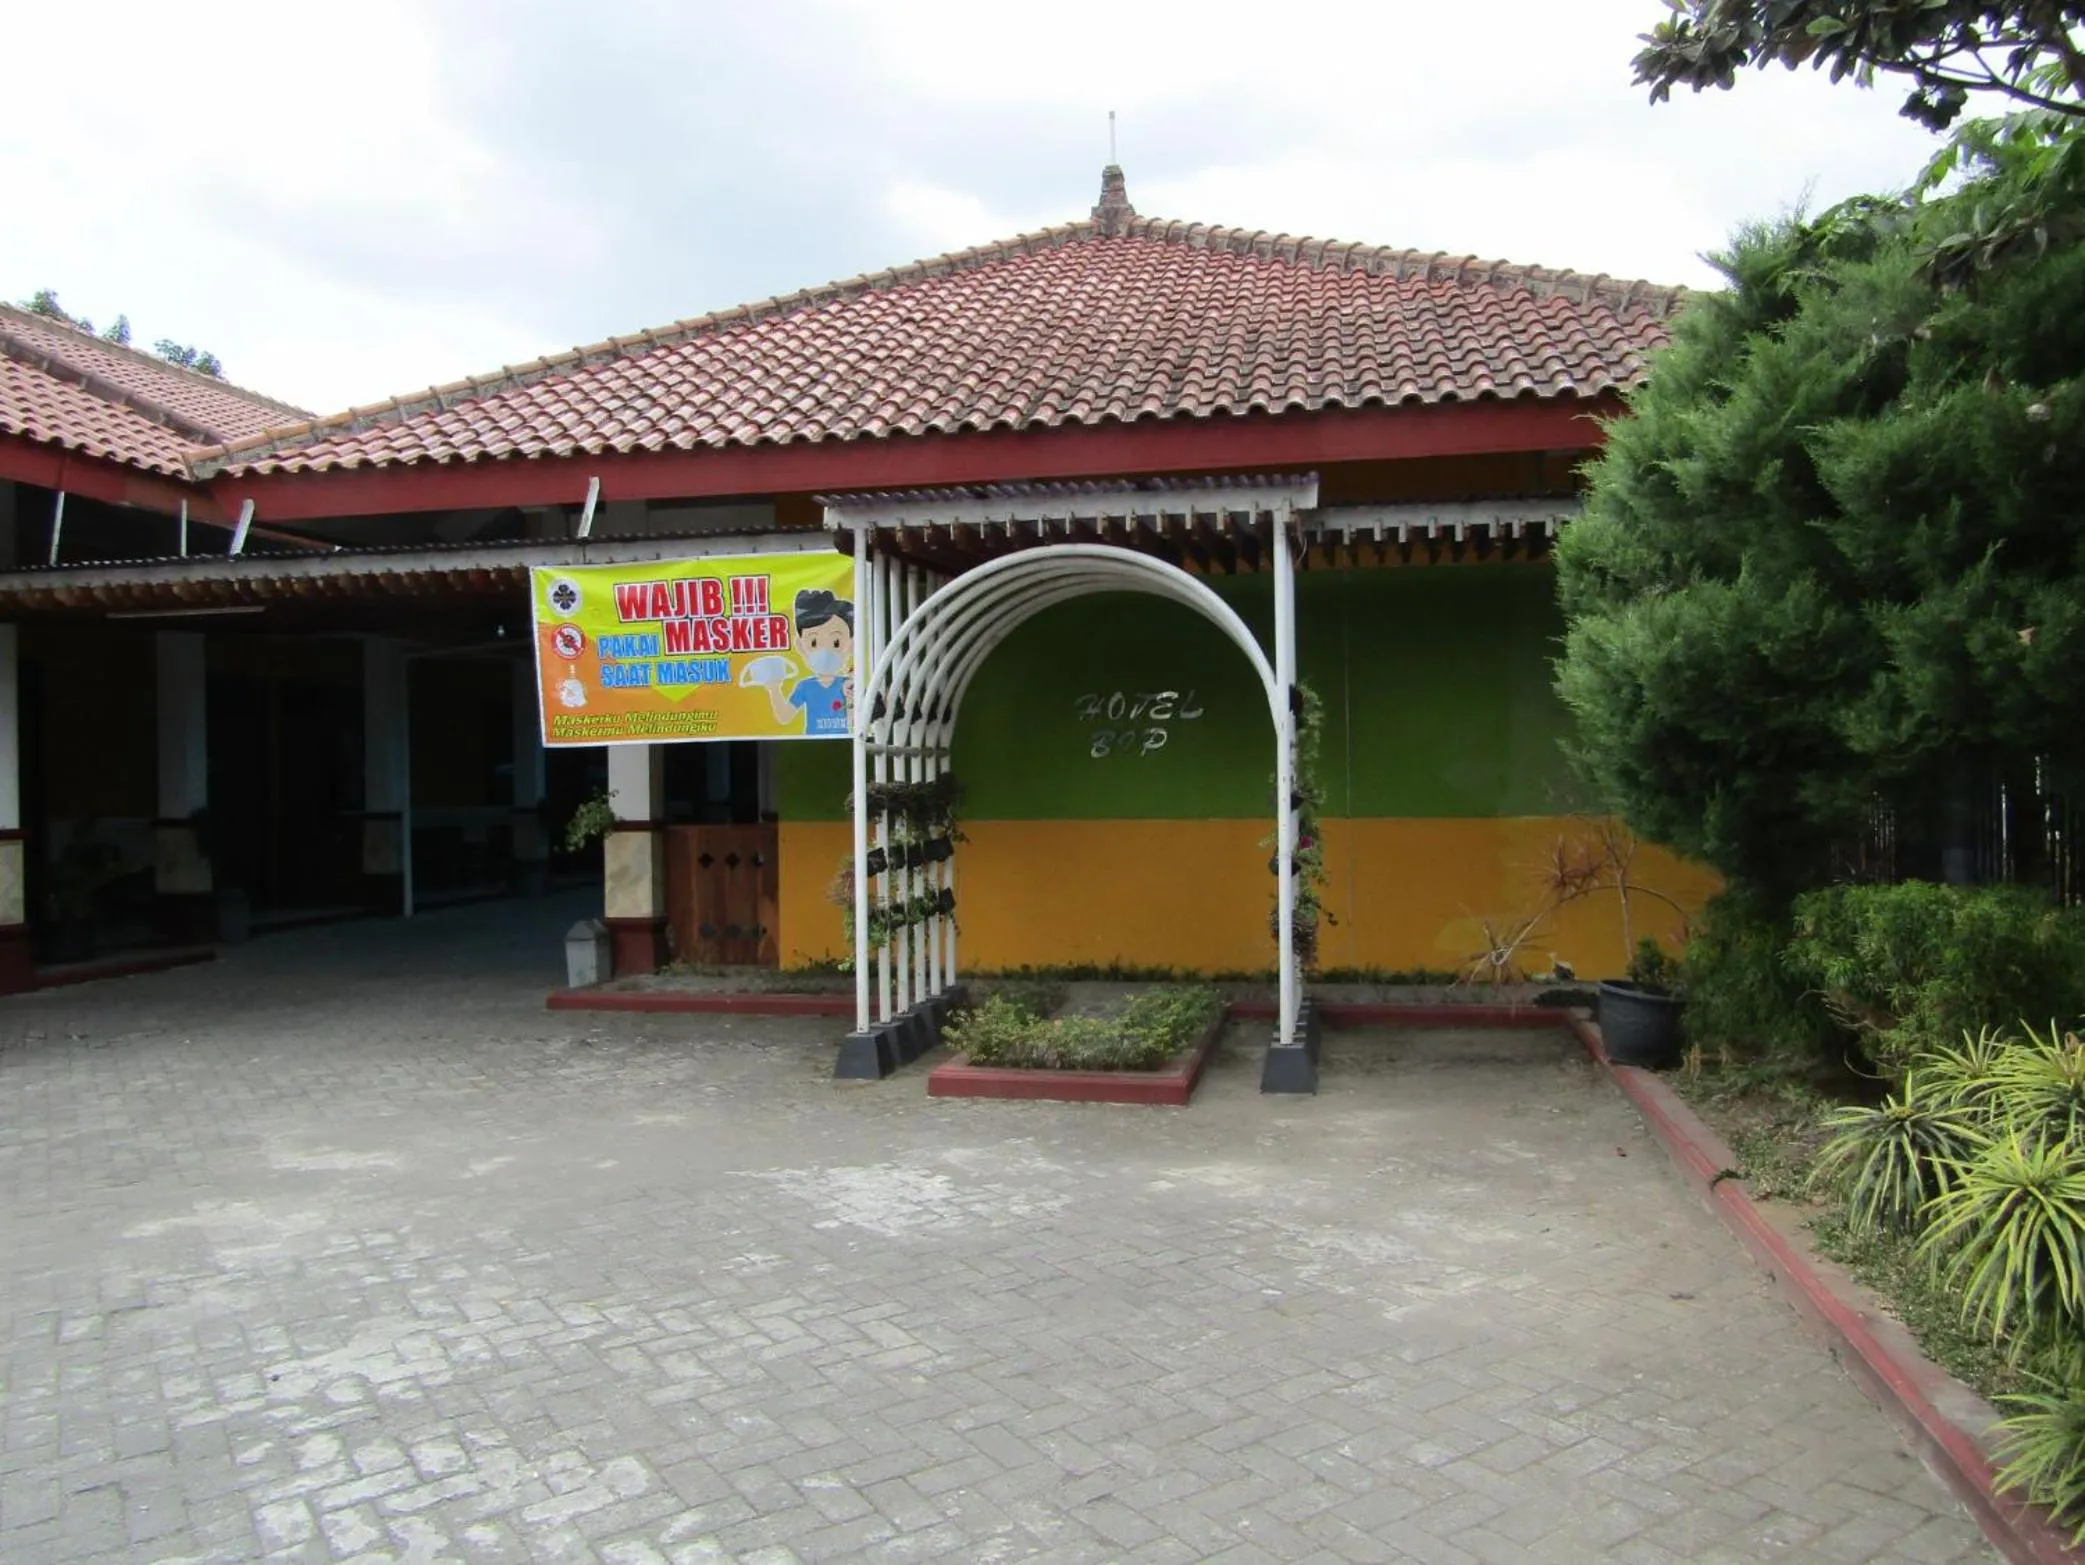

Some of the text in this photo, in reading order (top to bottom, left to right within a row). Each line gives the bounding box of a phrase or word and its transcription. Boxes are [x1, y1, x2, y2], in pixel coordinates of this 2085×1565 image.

[614, 578, 724, 622] WAJIB
[598, 615, 789, 659] PAKAI MASKER
[601, 658, 732, 688] SAAT MASUK
[552, 714, 620, 726] Maskerku
[1075, 689, 1205, 721] HOTEL
[552, 725, 622, 738] Maskermu
